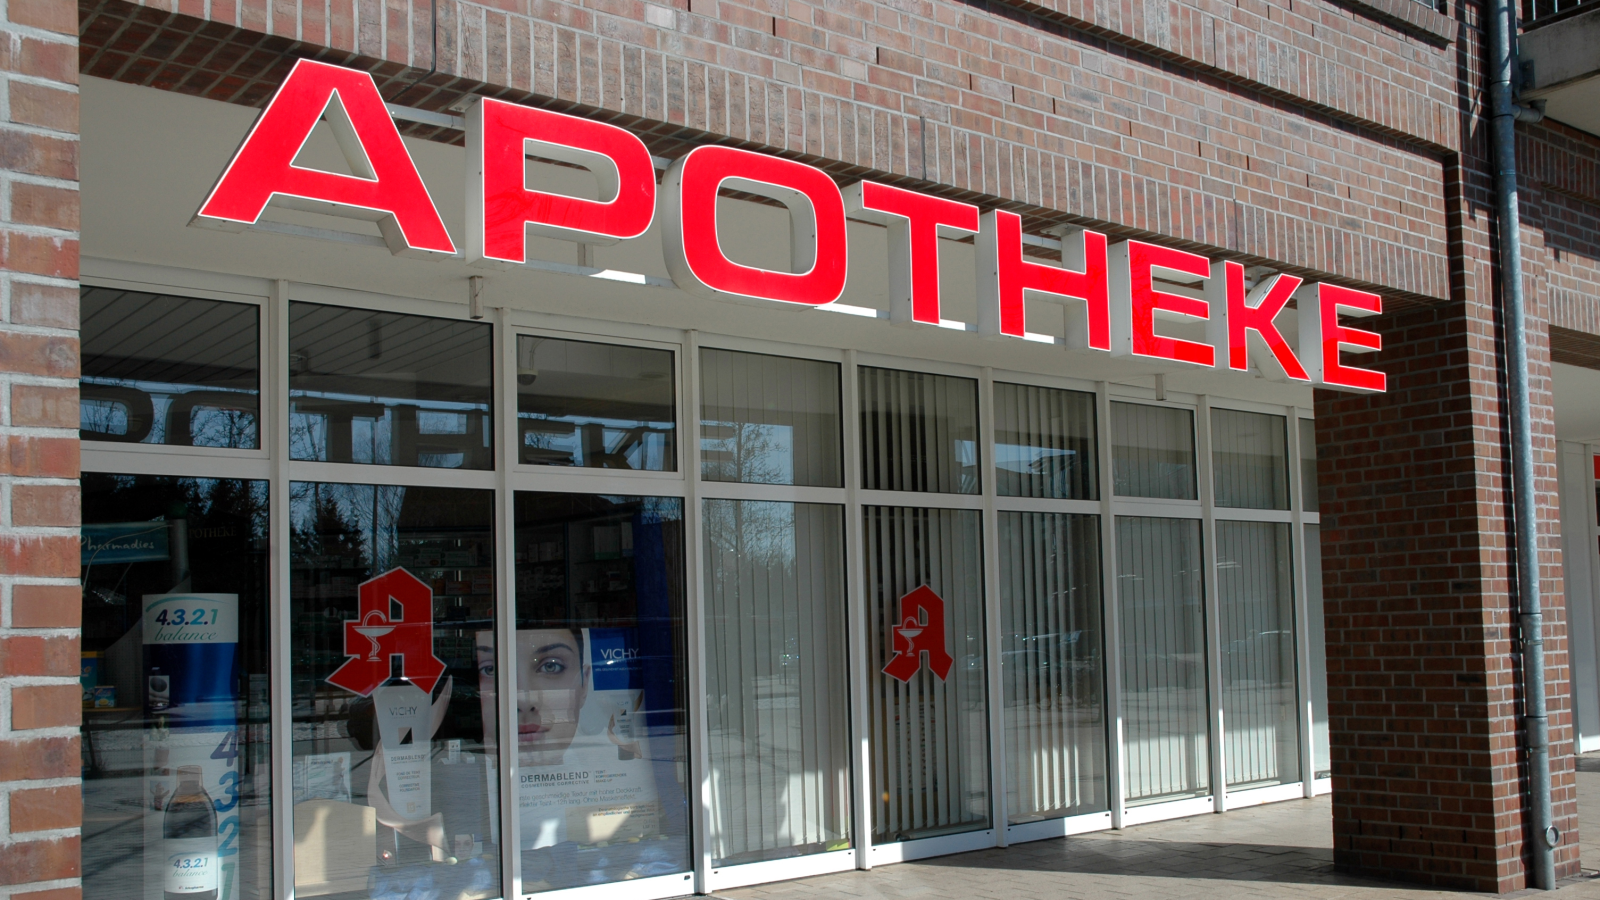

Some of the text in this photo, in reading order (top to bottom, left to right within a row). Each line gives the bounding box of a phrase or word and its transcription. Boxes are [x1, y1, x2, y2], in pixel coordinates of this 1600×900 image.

[197, 57, 1388, 394] APOTHEKE
[188, 525, 237, 539] POTHEKE
[155, 608, 219, 626] 4.3.2.1
[154, 626, 218, 641] balance
[600, 647, 640, 660] VICHY
[389, 706, 418, 716] VICHY
[520, 771, 589, 784] DERMABLEND
[173, 857, 209, 870] 4.3.2.1
[172, 869, 208, 878] balance
